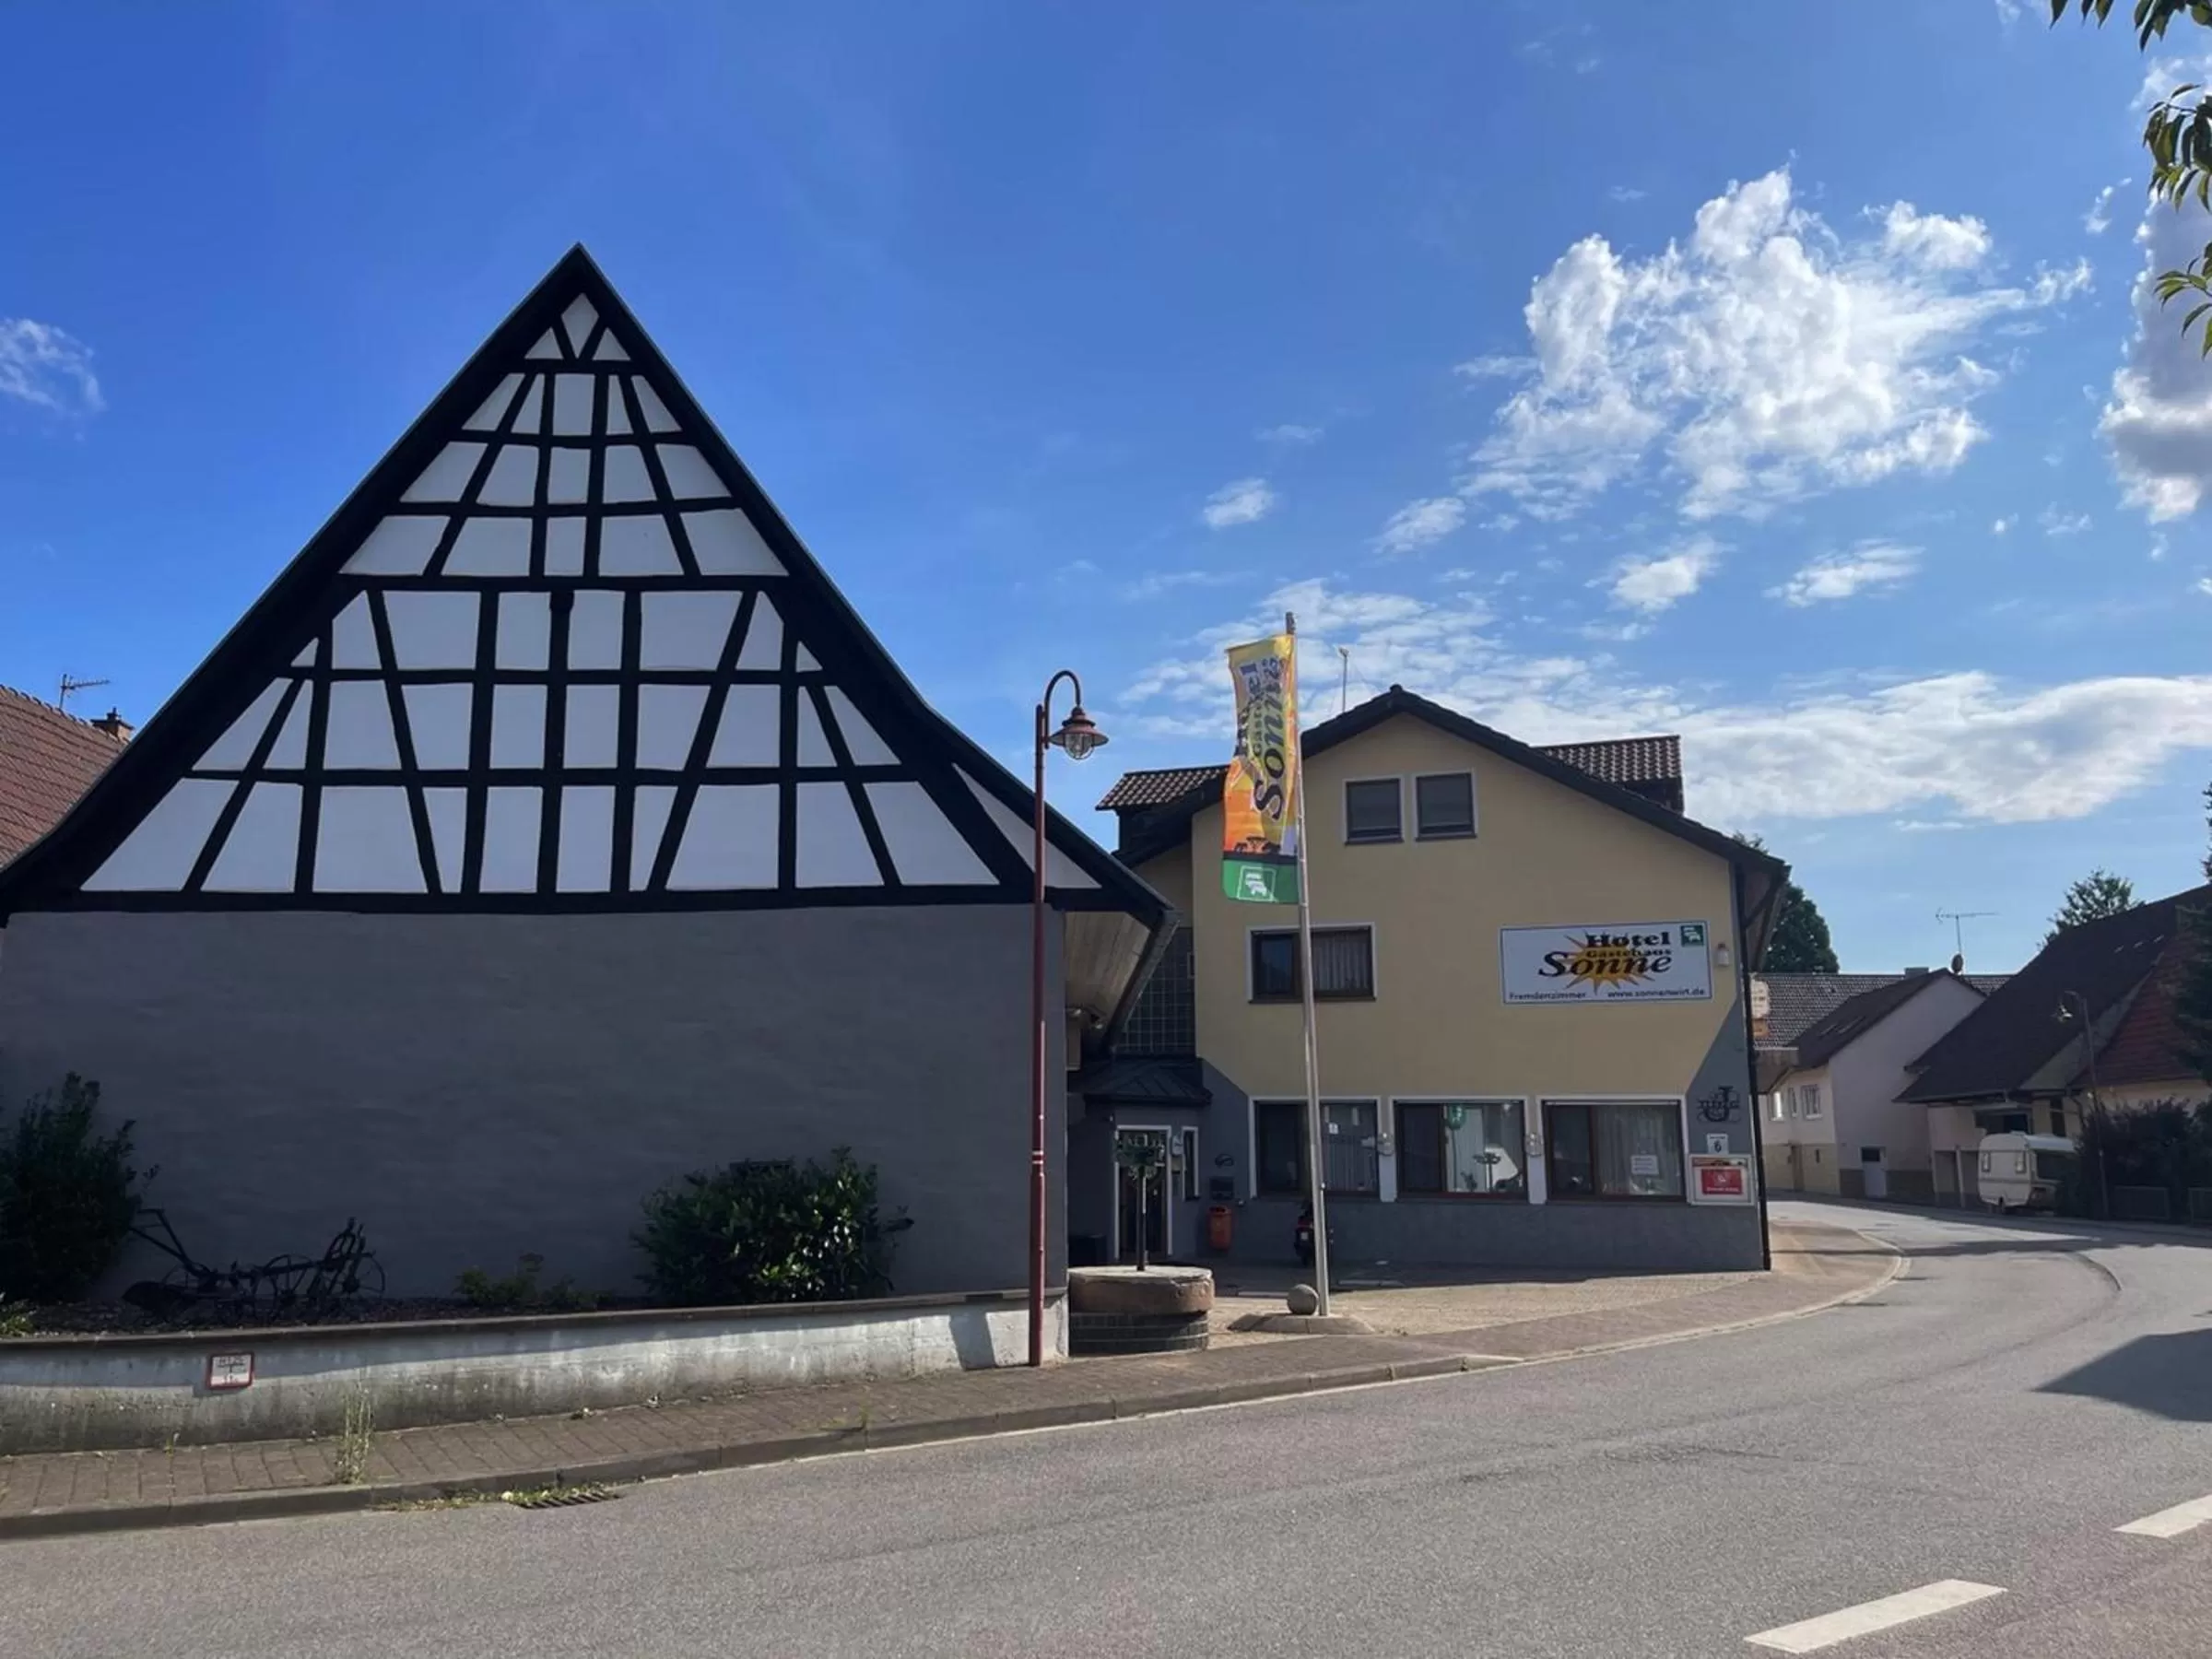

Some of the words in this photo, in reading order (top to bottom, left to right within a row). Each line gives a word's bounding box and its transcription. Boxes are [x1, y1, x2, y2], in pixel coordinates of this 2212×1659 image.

[1584, 931, 1672, 948] Hotel
[1537, 950, 1673, 978] Sonne
[1509, 991, 1587, 1001] Fremdenzimmer
